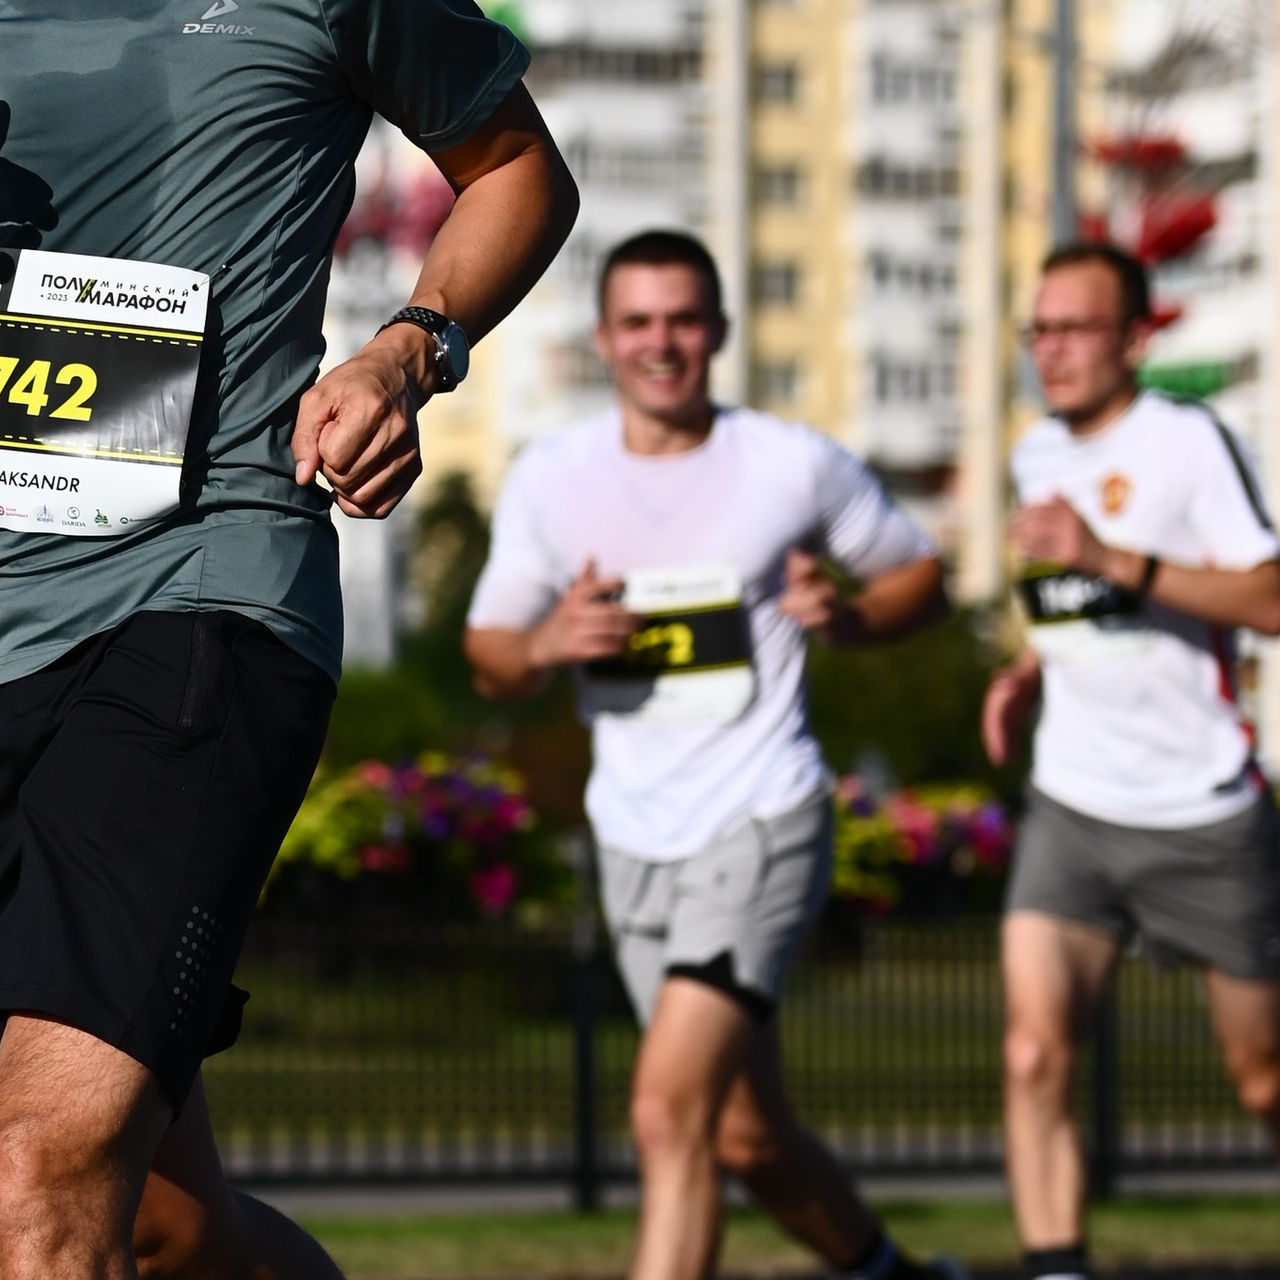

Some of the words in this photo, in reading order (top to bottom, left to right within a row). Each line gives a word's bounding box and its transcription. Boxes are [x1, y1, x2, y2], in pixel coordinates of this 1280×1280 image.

[182, 23, 256, 36] DEMIX
[40, 274, 97, 302] ПОЛУ
[47, 292, 68, 302] 2023
[81, 286, 187, 314] МАРАФОН
